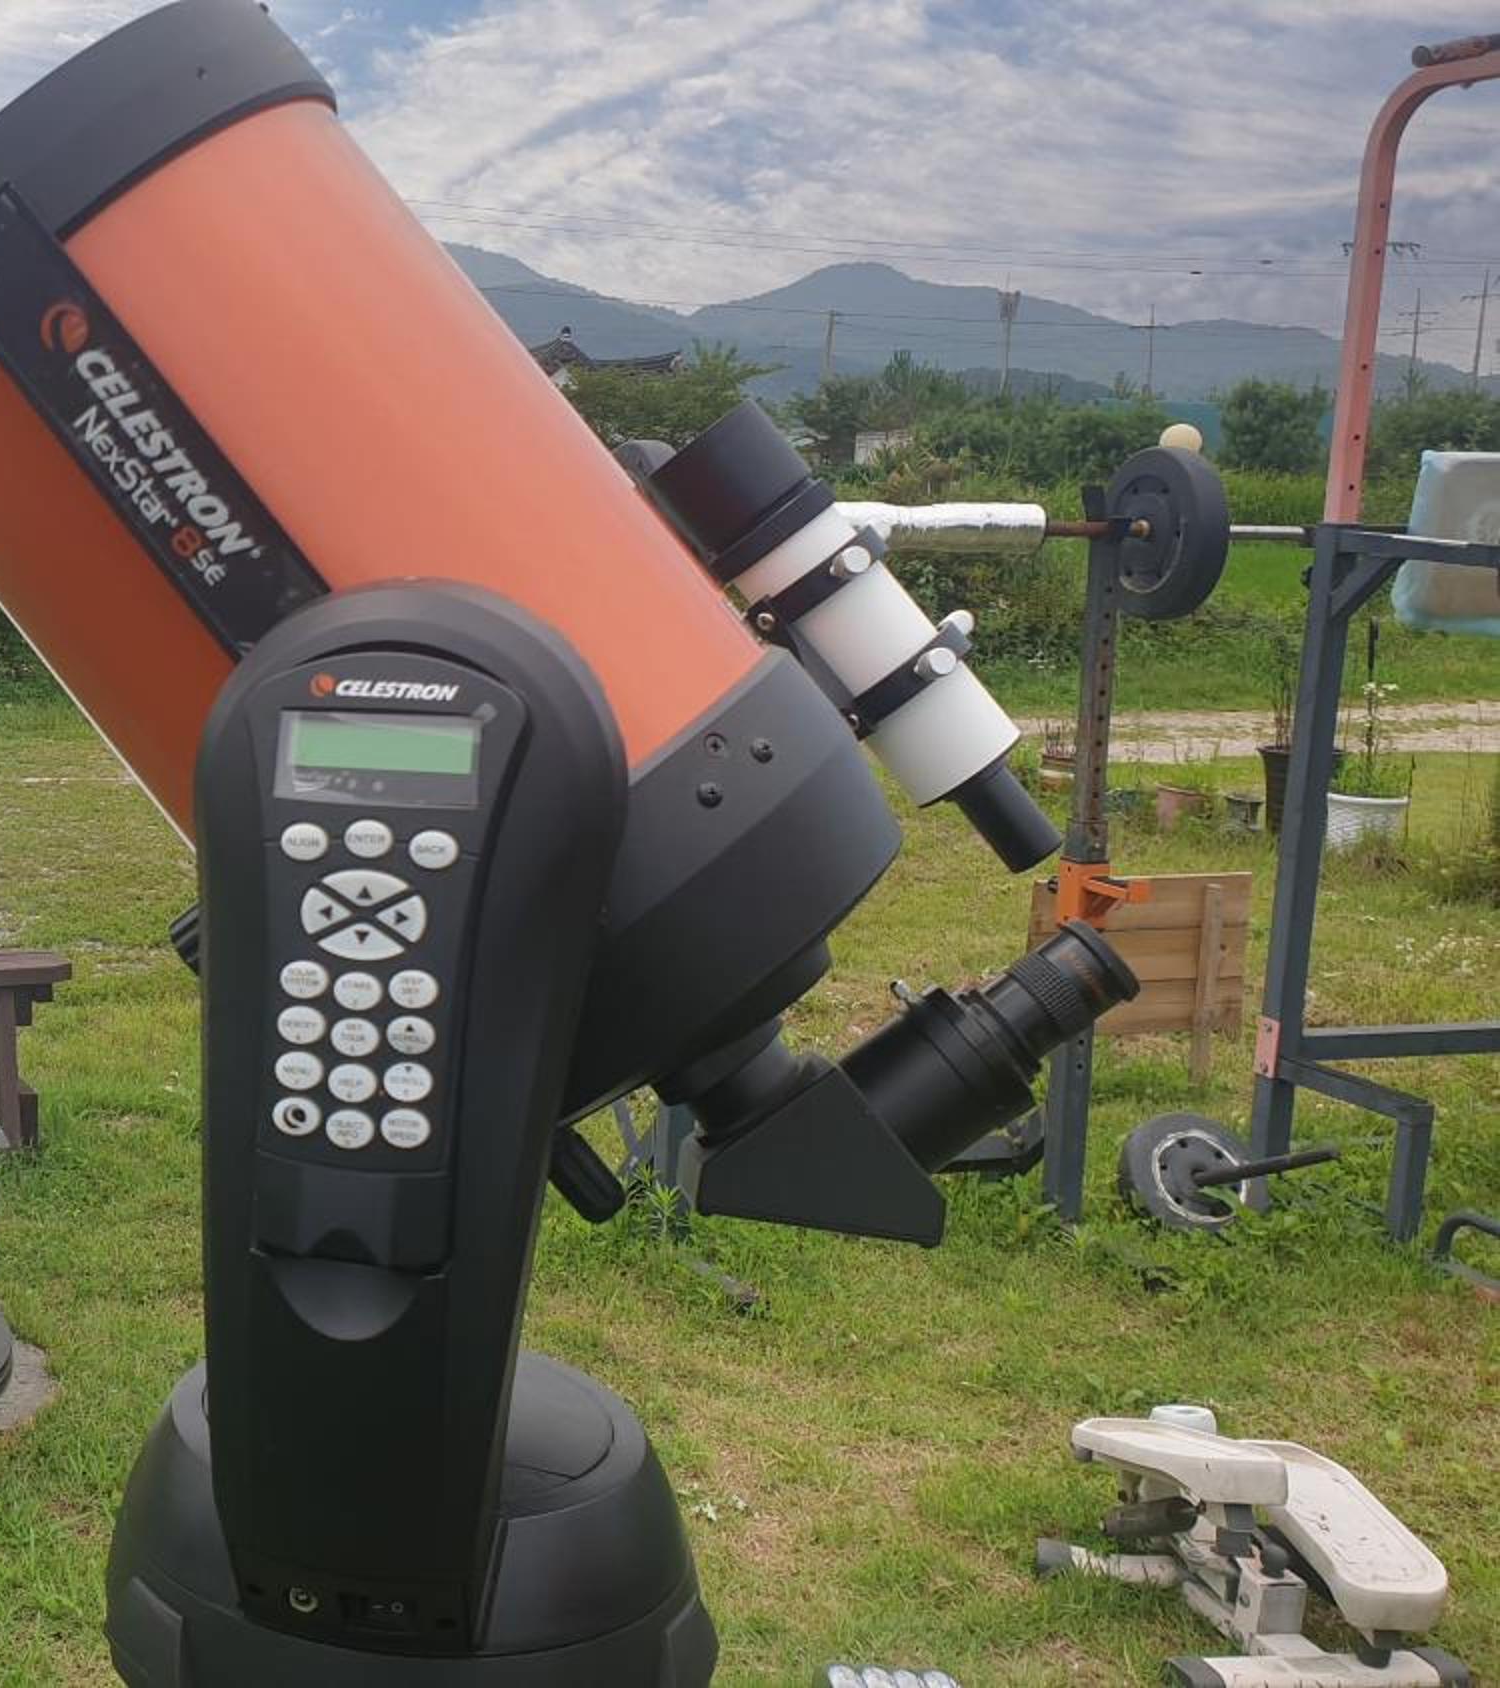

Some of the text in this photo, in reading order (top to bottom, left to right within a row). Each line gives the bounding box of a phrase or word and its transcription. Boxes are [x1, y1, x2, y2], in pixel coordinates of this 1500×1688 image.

[73, 405, 171, 527] NexStar
[76, 350, 255, 556] CELESTRON
[335, 680, 459, 701] CELESTRON
